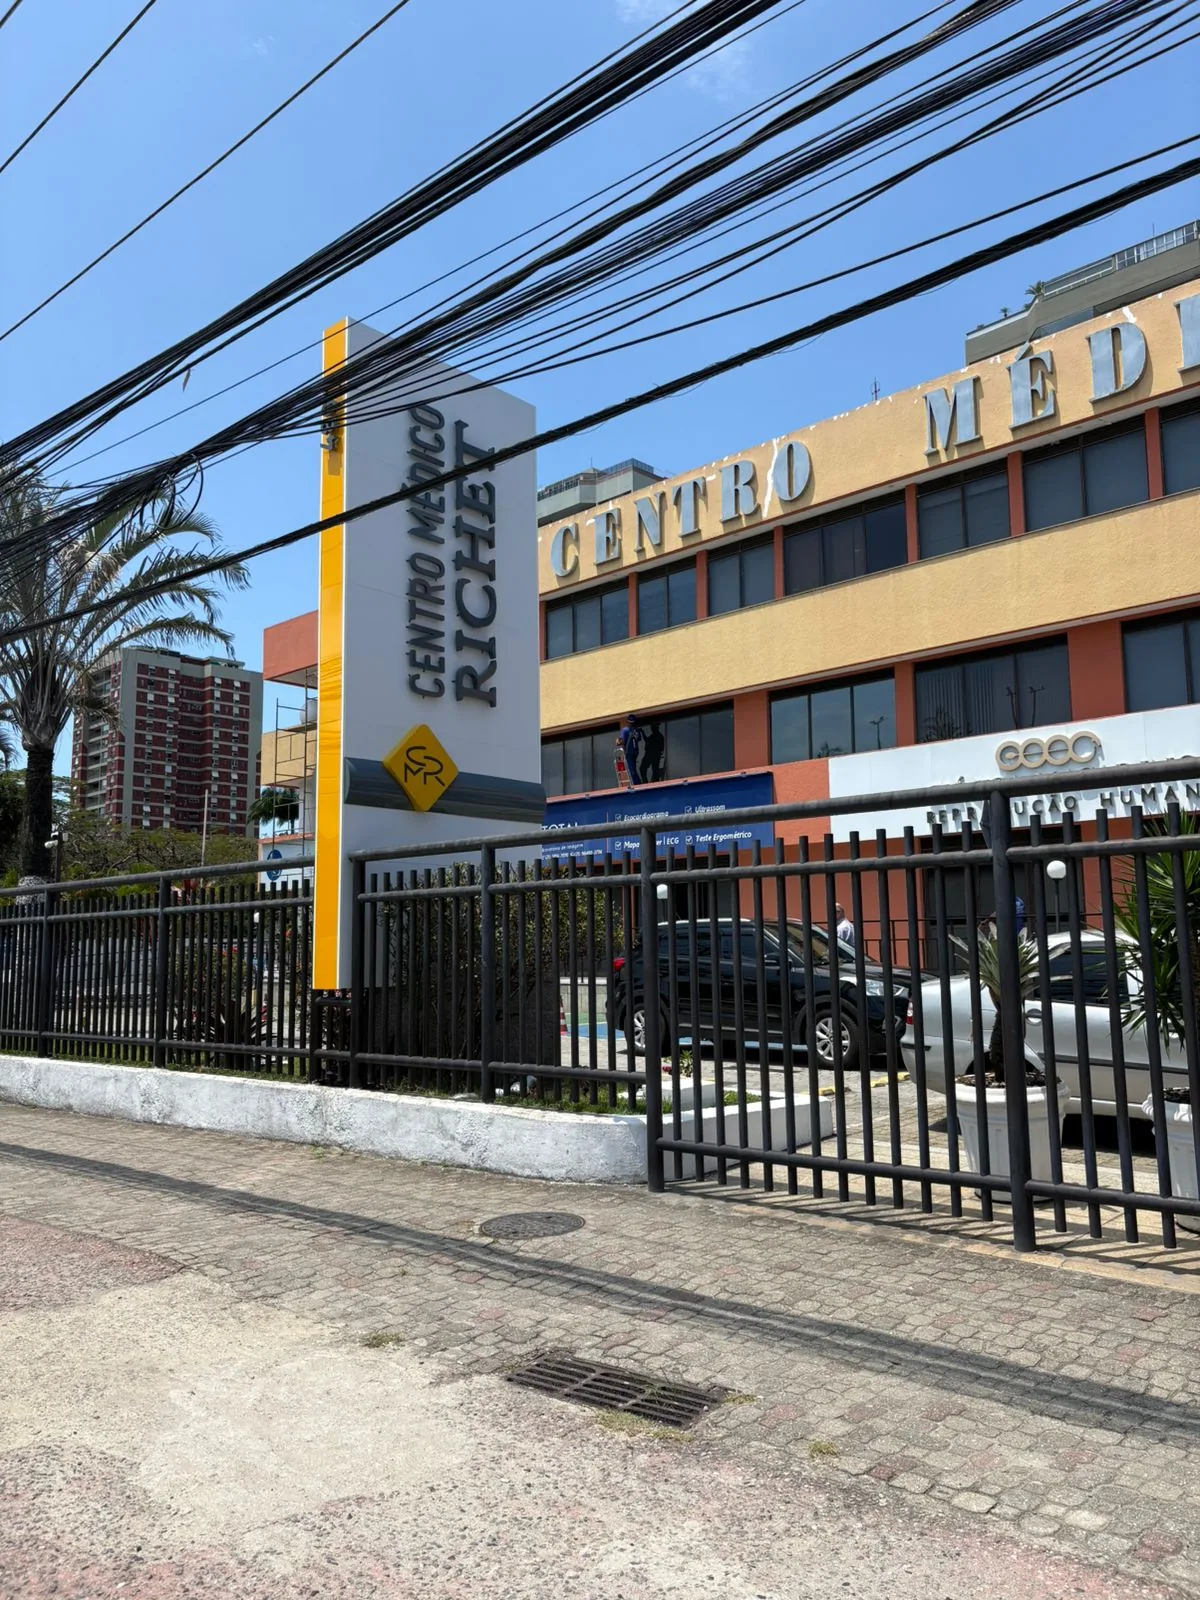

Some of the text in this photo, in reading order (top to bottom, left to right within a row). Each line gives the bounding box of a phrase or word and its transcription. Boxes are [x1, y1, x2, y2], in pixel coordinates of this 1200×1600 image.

[551, 293, 1200, 577] CENTRO MÉDI
[401, 403, 445, 698] CENTRO MÉDICO
[453, 419, 497, 708] RICHET
[666, 837, 680, 846] ECG
[695, 830, 752, 843] Teste Ergométrico
[926, 794, 1077, 824] REPRUÇÃO
